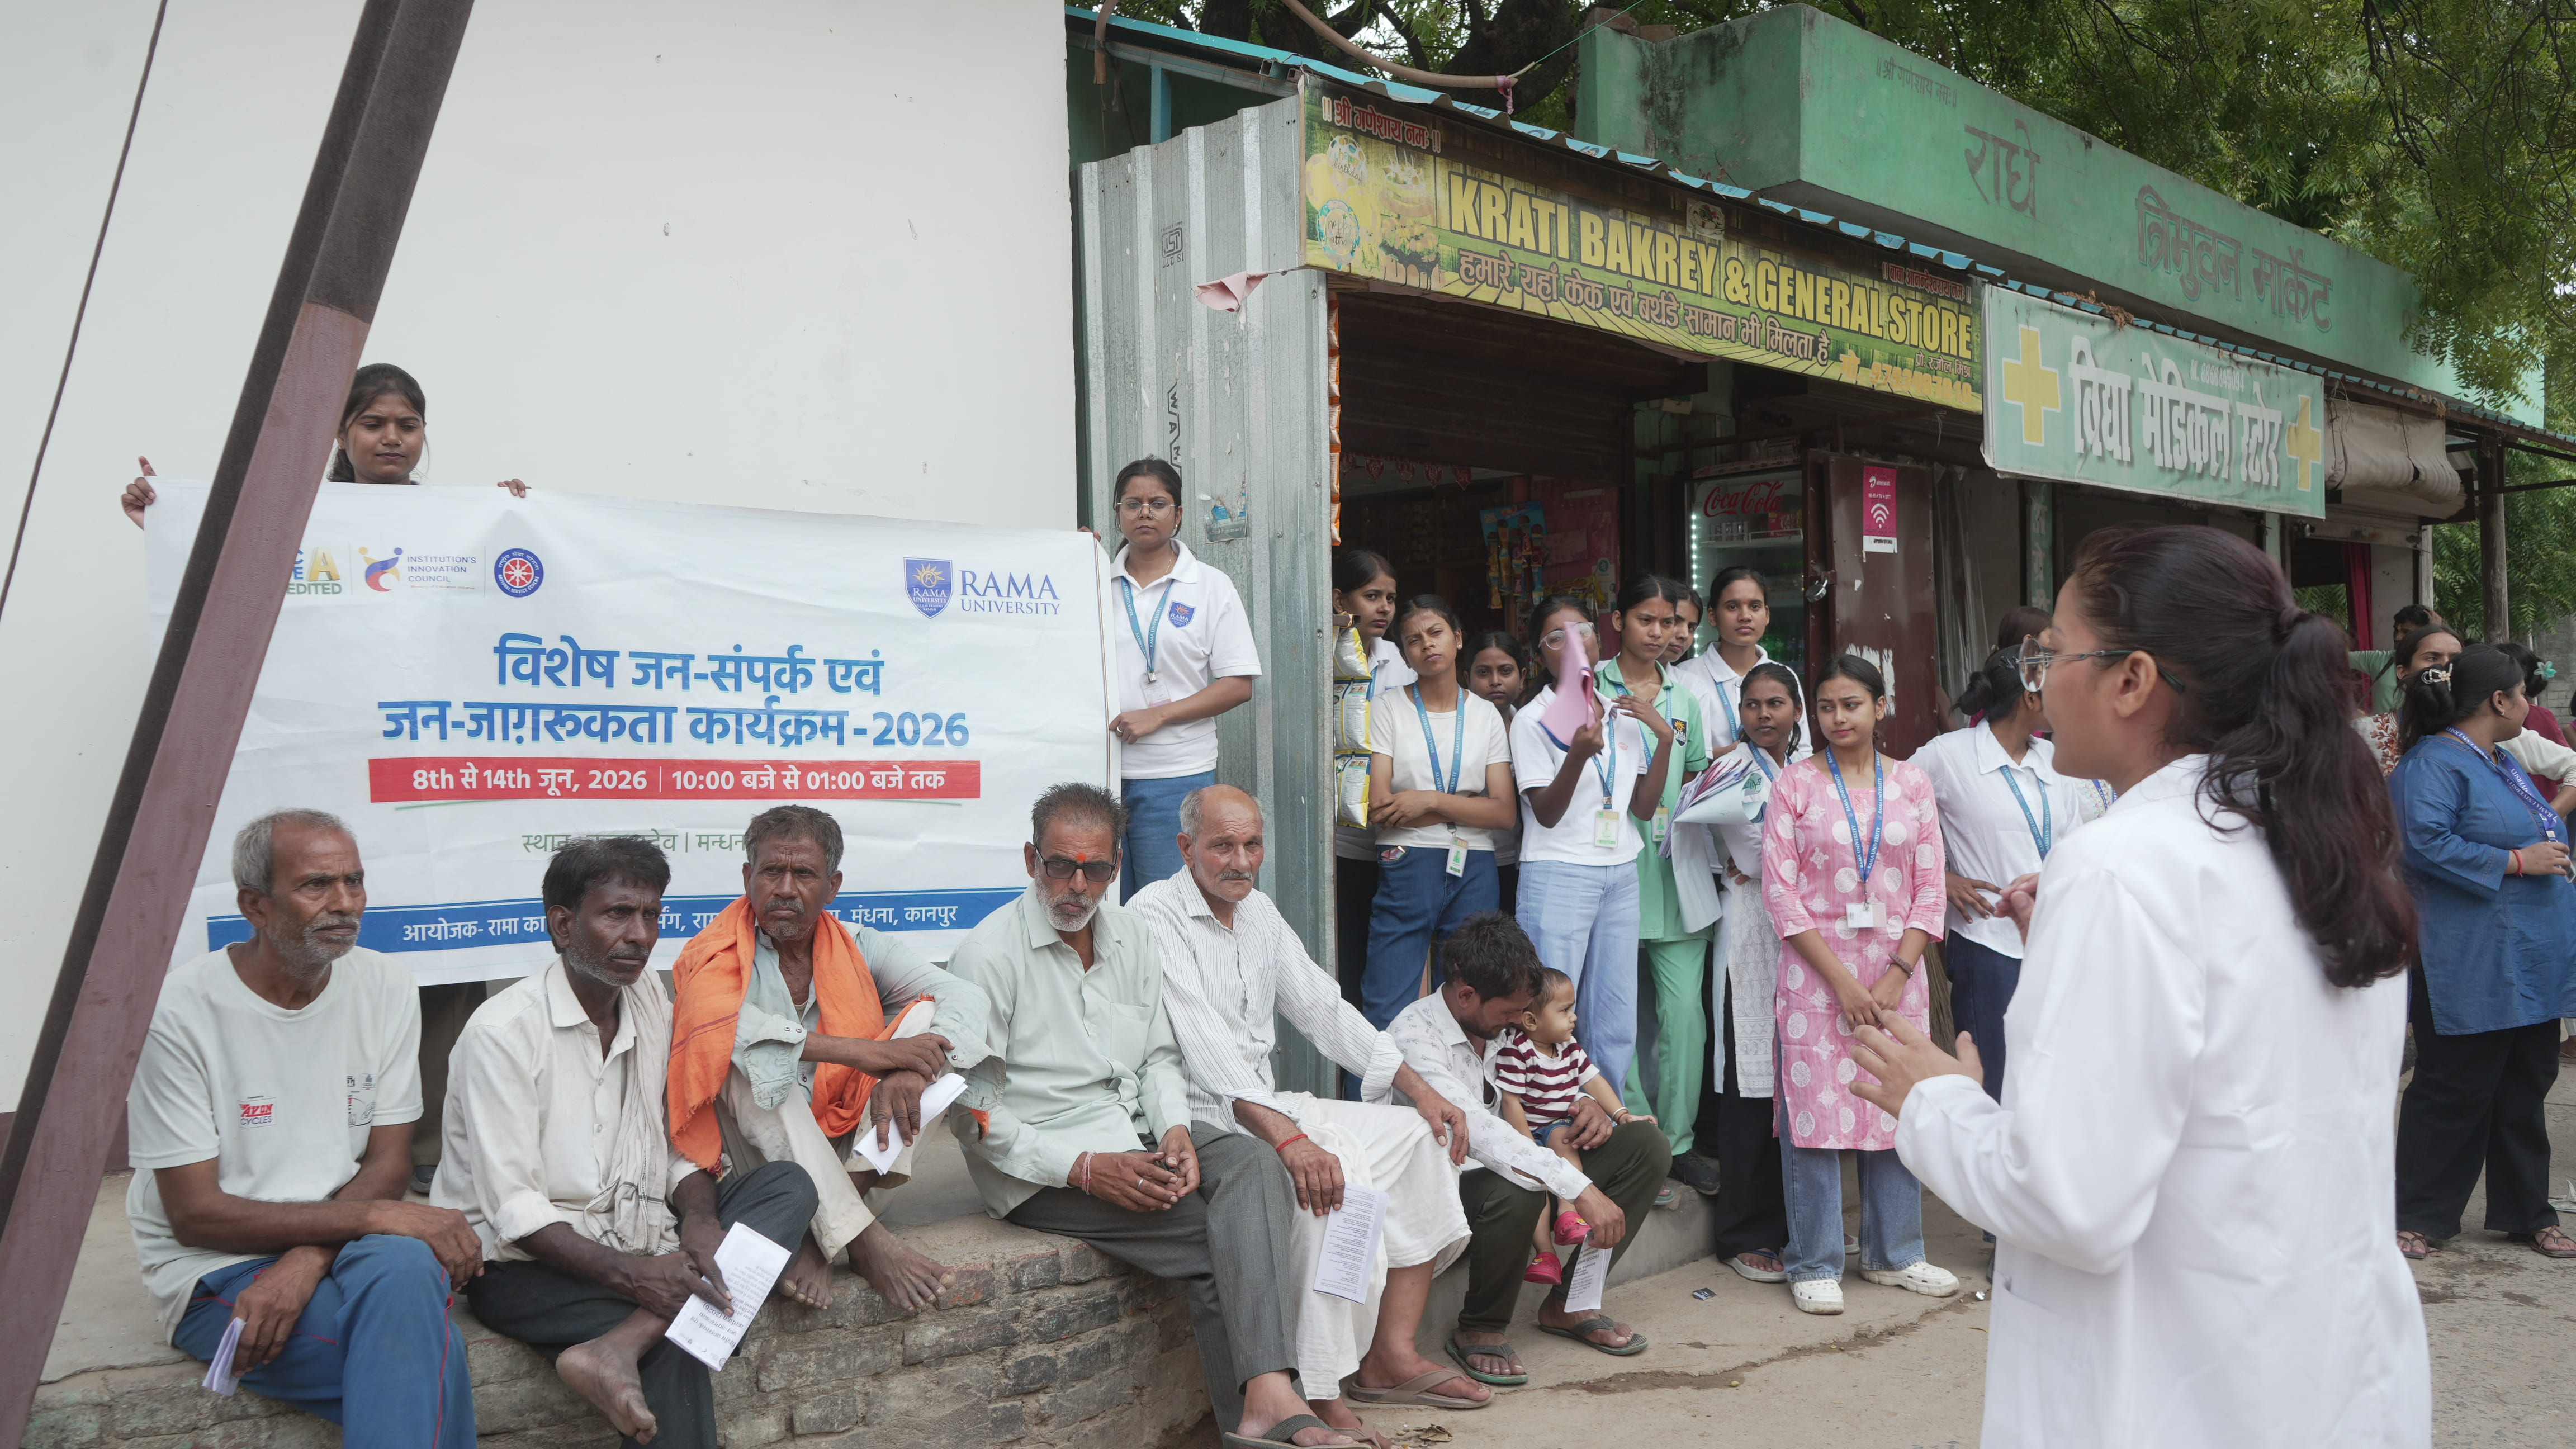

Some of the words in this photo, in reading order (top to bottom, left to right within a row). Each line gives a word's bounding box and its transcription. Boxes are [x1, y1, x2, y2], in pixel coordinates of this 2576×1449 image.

[1334, 97, 1352, 126] श्री
[1354, 105, 1402, 141] गणेशाय
[1405, 122, 1429, 148] नमः
[1332, 158, 1363, 186] birthday
[1963, 119, 2040, 219] राधे
[1448, 171, 1569, 260] KRATI
[1579, 209, 1720, 297] BAKREY
[1725, 257, 1750, 307] &
[1756, 258, 1883, 340] GENERAL
[1888, 293, 1972, 361] STORE
[1889, 263, 1904, 284] बाबा
[2252, 245, 2333, 333] मार्केट
[1459, 249, 1516, 293] हमारे
[1564, 268, 1605, 310] केक
[1608, 280, 1635, 319] एवं
[1684, 304, 1738, 343] सामान
[1740, 312, 1763, 350] भी
[1765, 315, 1815, 361] मिलता
[1816, 329, 1831, 366] है
[2237, 381, 2283, 487] स्टोर
[286, 583, 342, 595] EDITED
[498, 574, 510, 591] NATIONAL
[527, 576, 540, 591] SCHEME
[912, 587, 948, 598] RAMA
[958, 570, 1060, 600] RAMA
[960, 599, 1061, 615] UNIVERSITY
[1151, 607, 1162, 634] UNIVERSITY
[494, 633, 620, 688] विशेष
[629, 644, 816, 694] जन-संपर्क
[823, 649, 885, 695] एवं
[1421, 713, 1433, 741] UNIVERSITY
[413, 768, 454, 789] 8th
[460, 762, 478, 789] से
[483, 769, 531, 789] 14th
[537, 769, 579, 796] जून,
[588, 770, 647, 789] 2026
[672, 771, 735, 790] 10:00
[741, 765, 776, 790] बजे
[781, 765, 801, 790] से
[807, 771, 865, 790] 01:00
[870, 765, 905, 790] बजे
[909, 771, 946, 789] तक
[1834, 774, 1847, 799] UNIVERSITY
[2507, 779, 2536, 806] UNIVERSITY
[2534, 802, 2553, 818] RAMA
[2026, 812, 2039, 838] UNIVERSITY
[1852, 825, 1862, 854] UNIVERSITY
[1871, 827, 1881, 855] UNIVERSITY
[487, 917, 518, 936] रामा
[904, 905, 958, 927] कानपुर
[239, 1104, 273, 1117] AVON
[240, 1115, 272, 1125] CYCLES
[702, 1302, 722, 1319] (2026)
